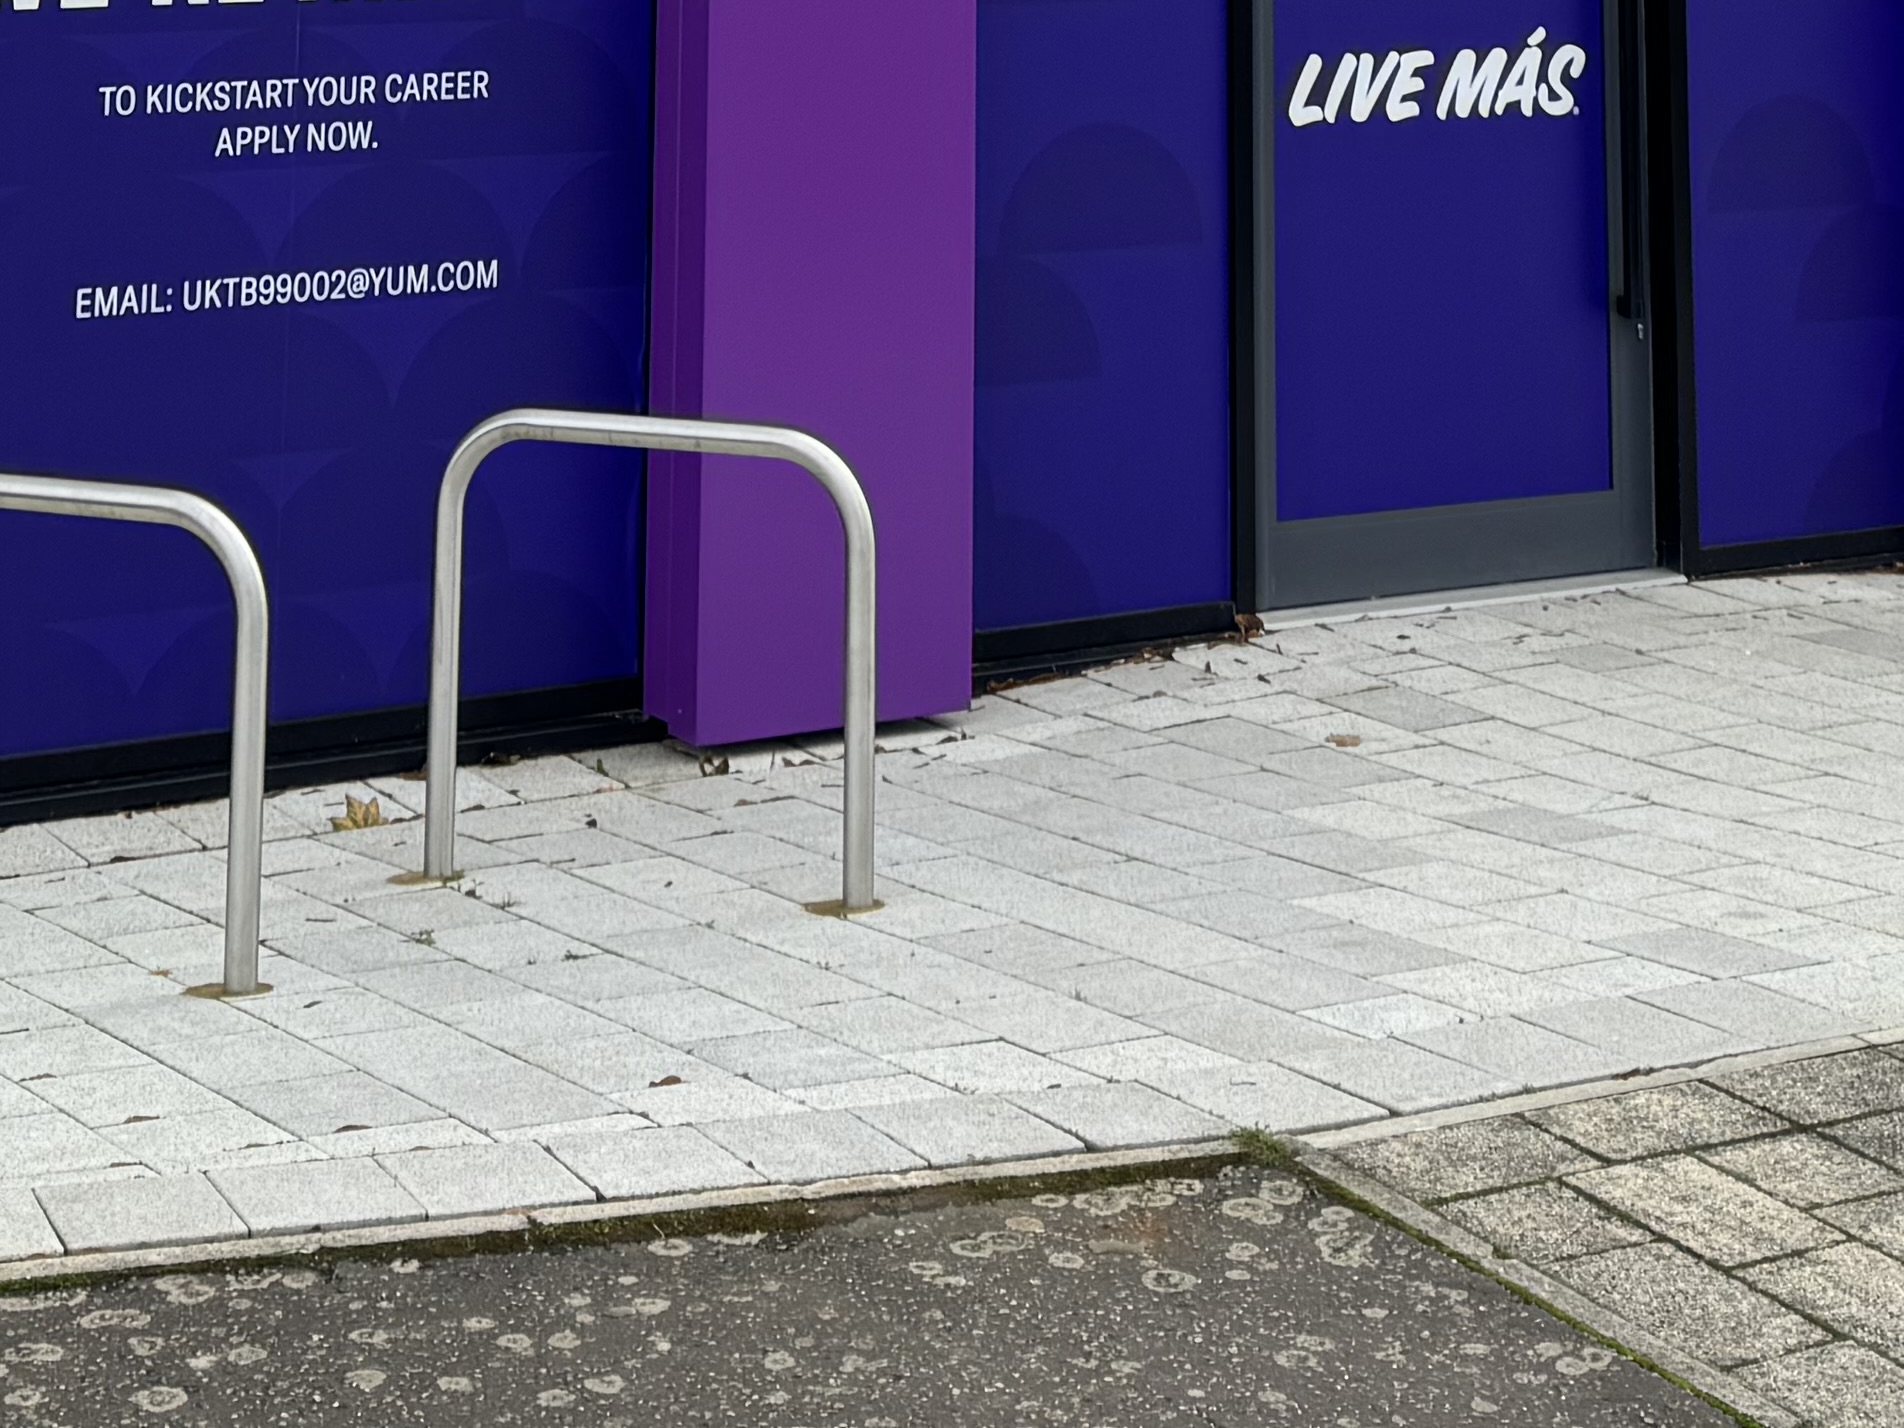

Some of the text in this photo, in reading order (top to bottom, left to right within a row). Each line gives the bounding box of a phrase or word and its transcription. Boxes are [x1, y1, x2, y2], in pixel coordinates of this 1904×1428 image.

[98, 70, 490, 116] TO KICKSTART YOUR CAREER
[1288, 49, 1435, 127] LIVE
[214, 120, 379, 157] APPLY NOW.
[76, 259, 499, 319] EMAIL: UKTB99002@YUM.COM
